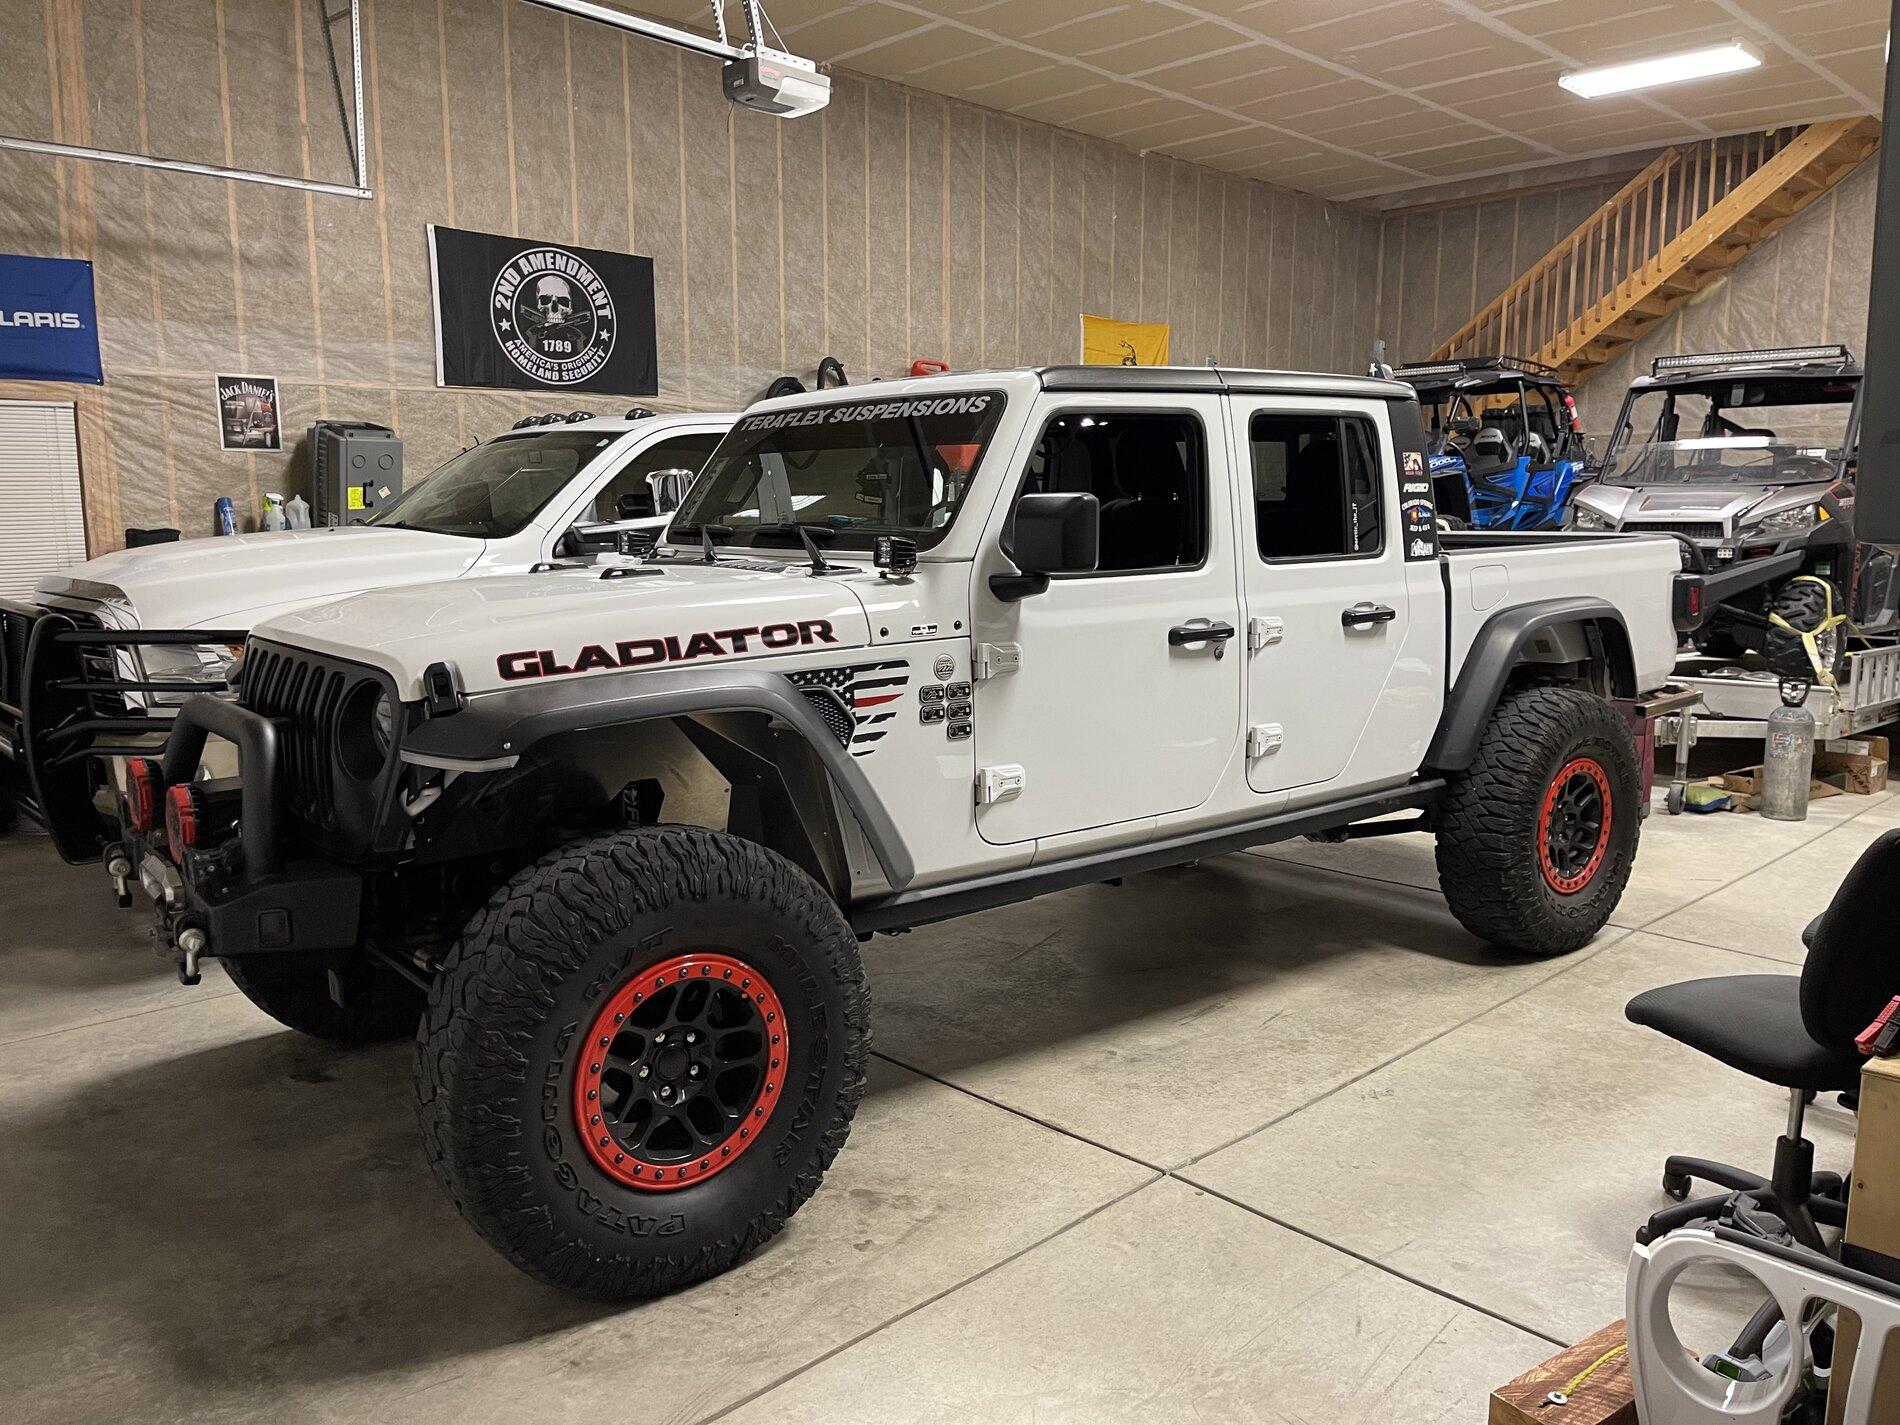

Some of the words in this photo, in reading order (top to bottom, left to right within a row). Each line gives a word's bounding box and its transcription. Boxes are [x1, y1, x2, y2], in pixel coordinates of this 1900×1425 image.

[494, 267, 521, 311] 2ND
[517, 252, 612, 320] AMENDMENT
[504, 339, 560, 381] HOMELAND
[561, 349, 606, 381] SECURITY
[513, 338, 560, 371] AMERICA'S
[561, 345, 598, 371] ORIGINAL
[542, 339, 572, 353] 1789
[220, 384, 242, 400] JACK
[740, 408, 832, 432] TERAFLEX
[830, 395, 992, 423] SUSPENSIONS
[1403, 483, 1429, 492] RIGID
[496, 619, 840, 682] GLADIATOR
[541, 1020, 687, 1237] PATAGONIA
